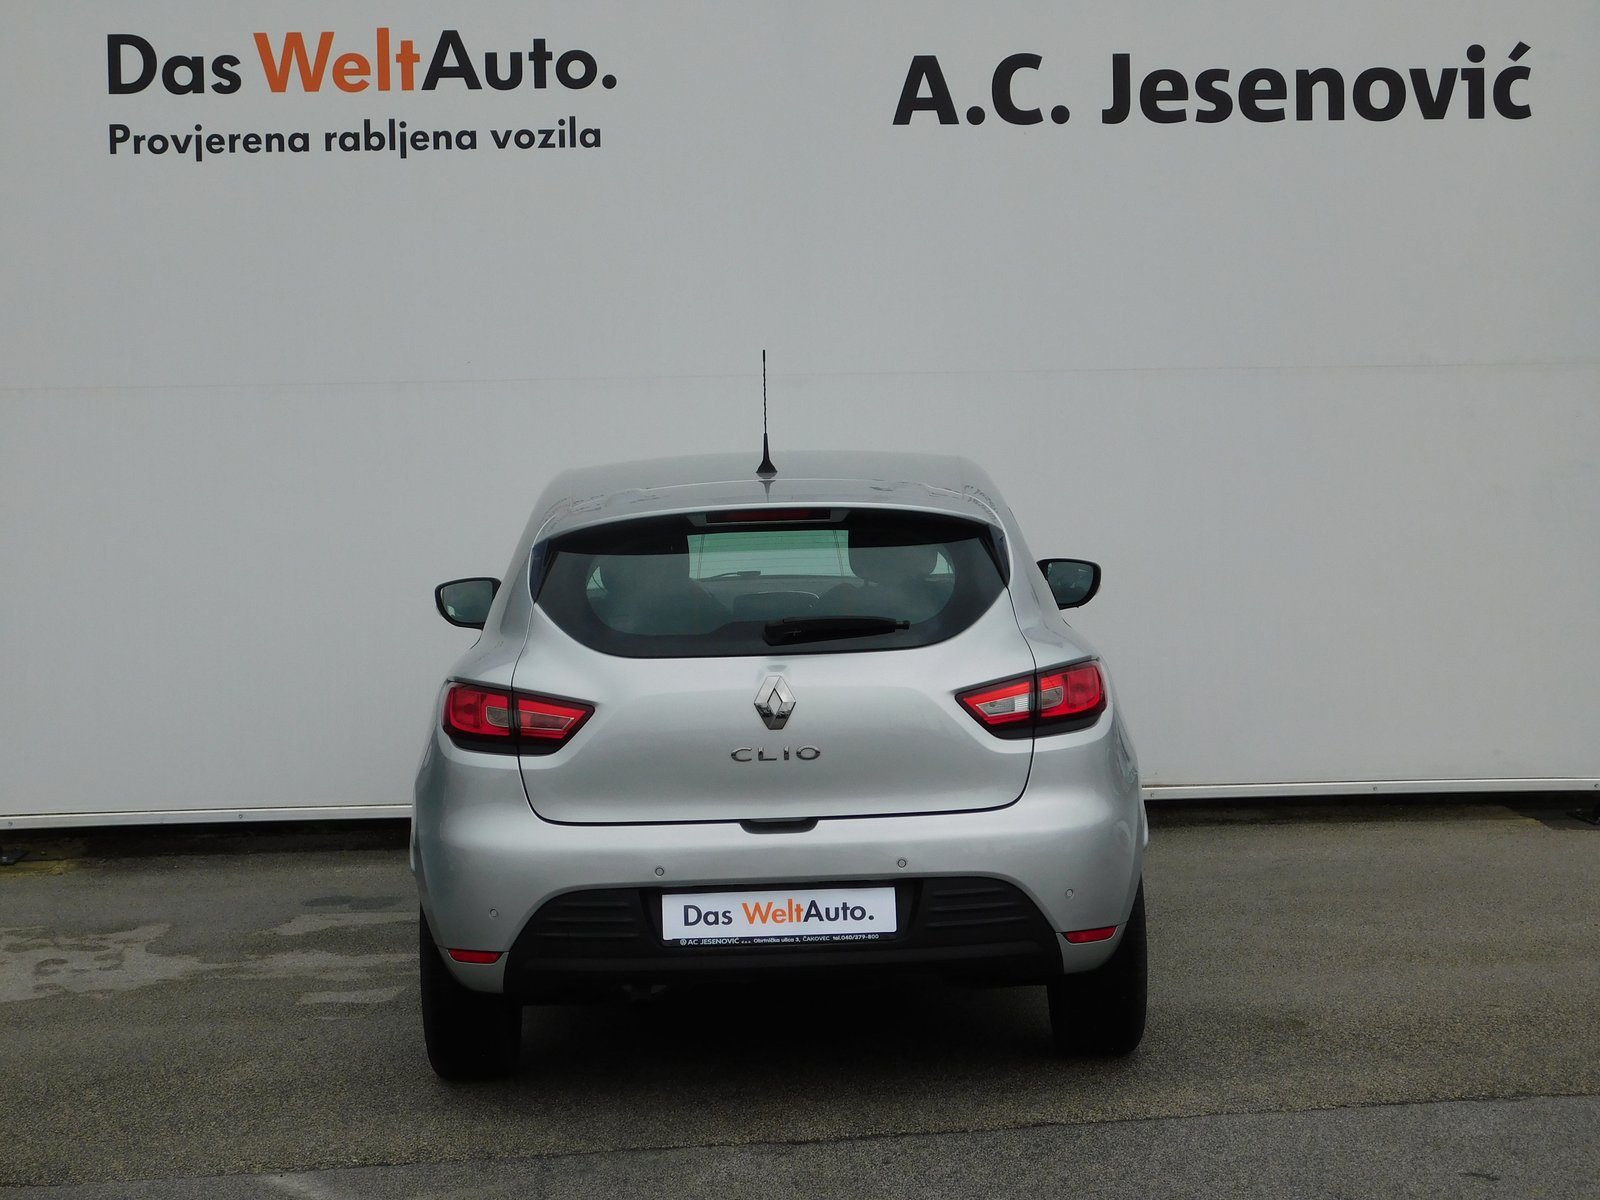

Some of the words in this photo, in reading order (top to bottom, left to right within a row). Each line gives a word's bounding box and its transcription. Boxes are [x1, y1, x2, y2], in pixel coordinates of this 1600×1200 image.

[107, 33, 242, 95] Das
[253, 27, 618, 93] WeltAuto.
[892, 53, 1070, 125] A.C.
[1102, 41, 1533, 124] Jesenović
[108, 122, 310, 162] Provjerena
[324, 118, 478, 159] rabljena
[491, 116, 602, 149] vozila
[730, 745, 821, 762] CLIO
[683, 904, 733, 926] Das
[742, 898, 875, 924] WeltAuto.
